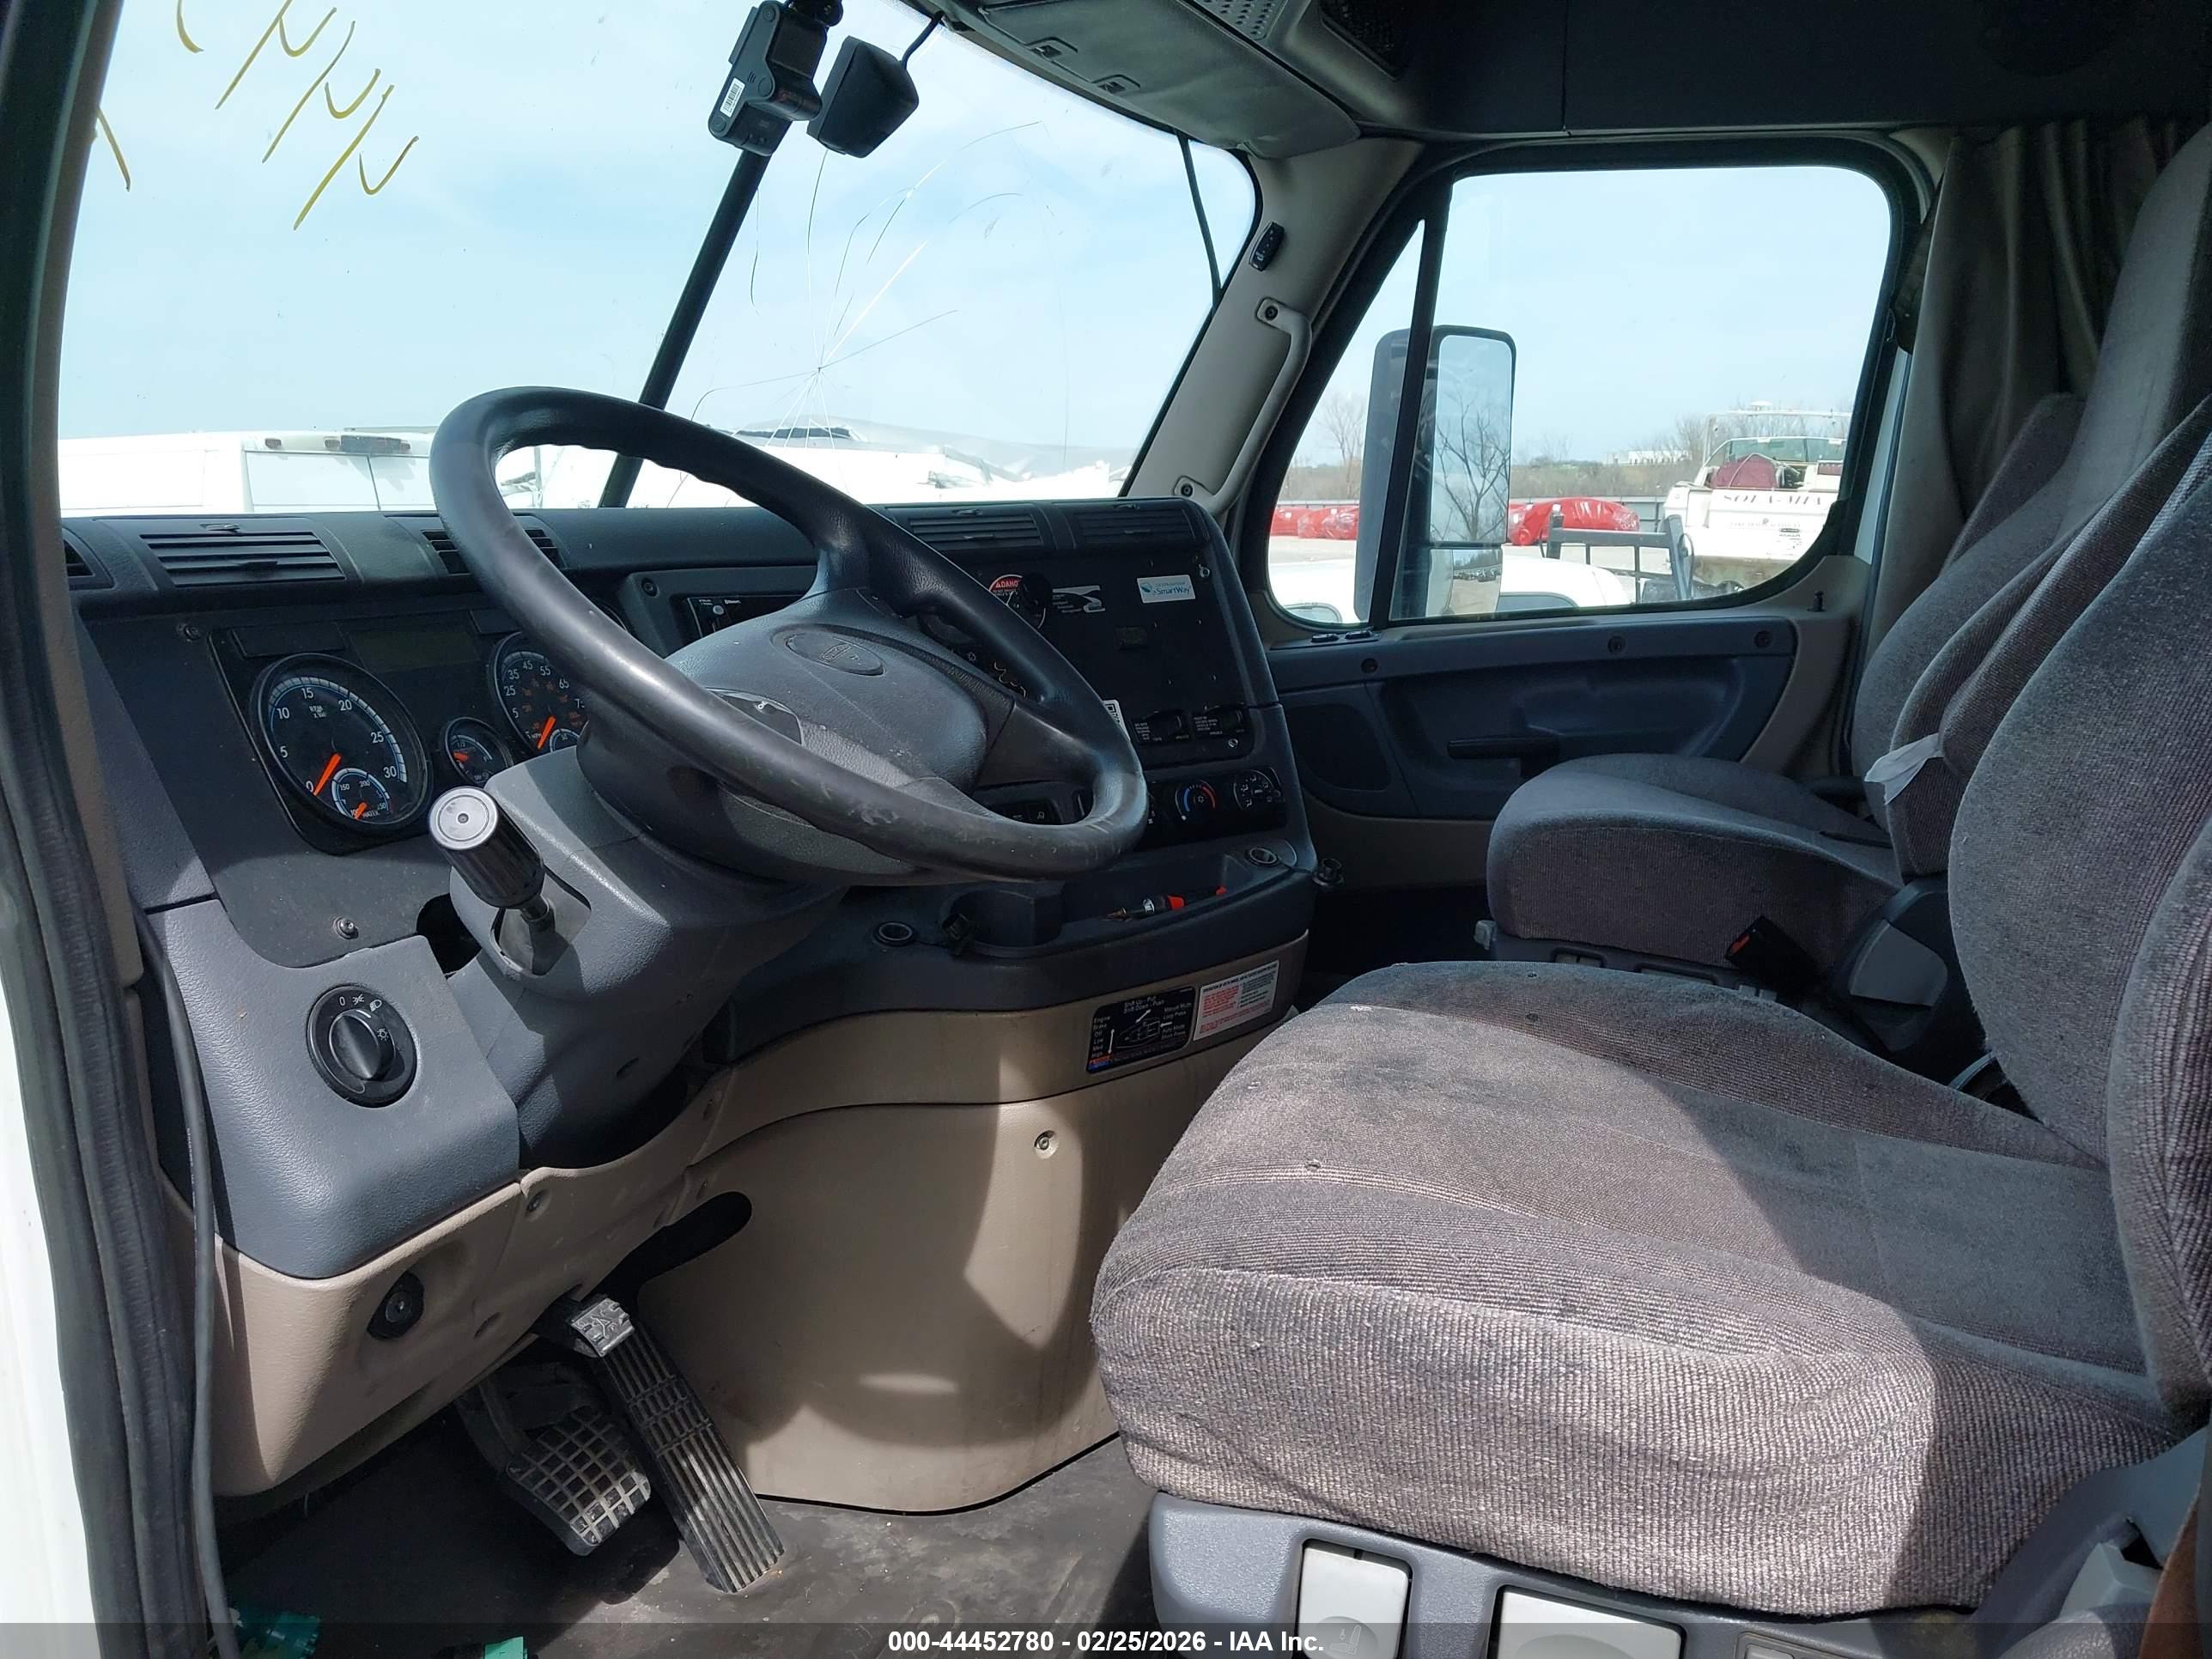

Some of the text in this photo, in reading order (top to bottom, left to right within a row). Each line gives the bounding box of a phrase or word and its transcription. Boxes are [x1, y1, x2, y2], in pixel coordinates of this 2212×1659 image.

[522, 659, 534, 670] 45
[539, 665, 551, 676] 55
[507, 668, 520, 680] 35
[503, 684, 516, 696] 25
[558, 678, 570, 690] 65
[301, 686, 314, 700] 15
[337, 699, 353, 711] 20
[276, 707, 290, 720] 10
[370, 732, 385, 744] 25
[280, 745, 289, 758] 5
[382, 765, 397, 779] 30
[305, 780, 314, 793] 0
[338, 996, 346, 1006] 0
